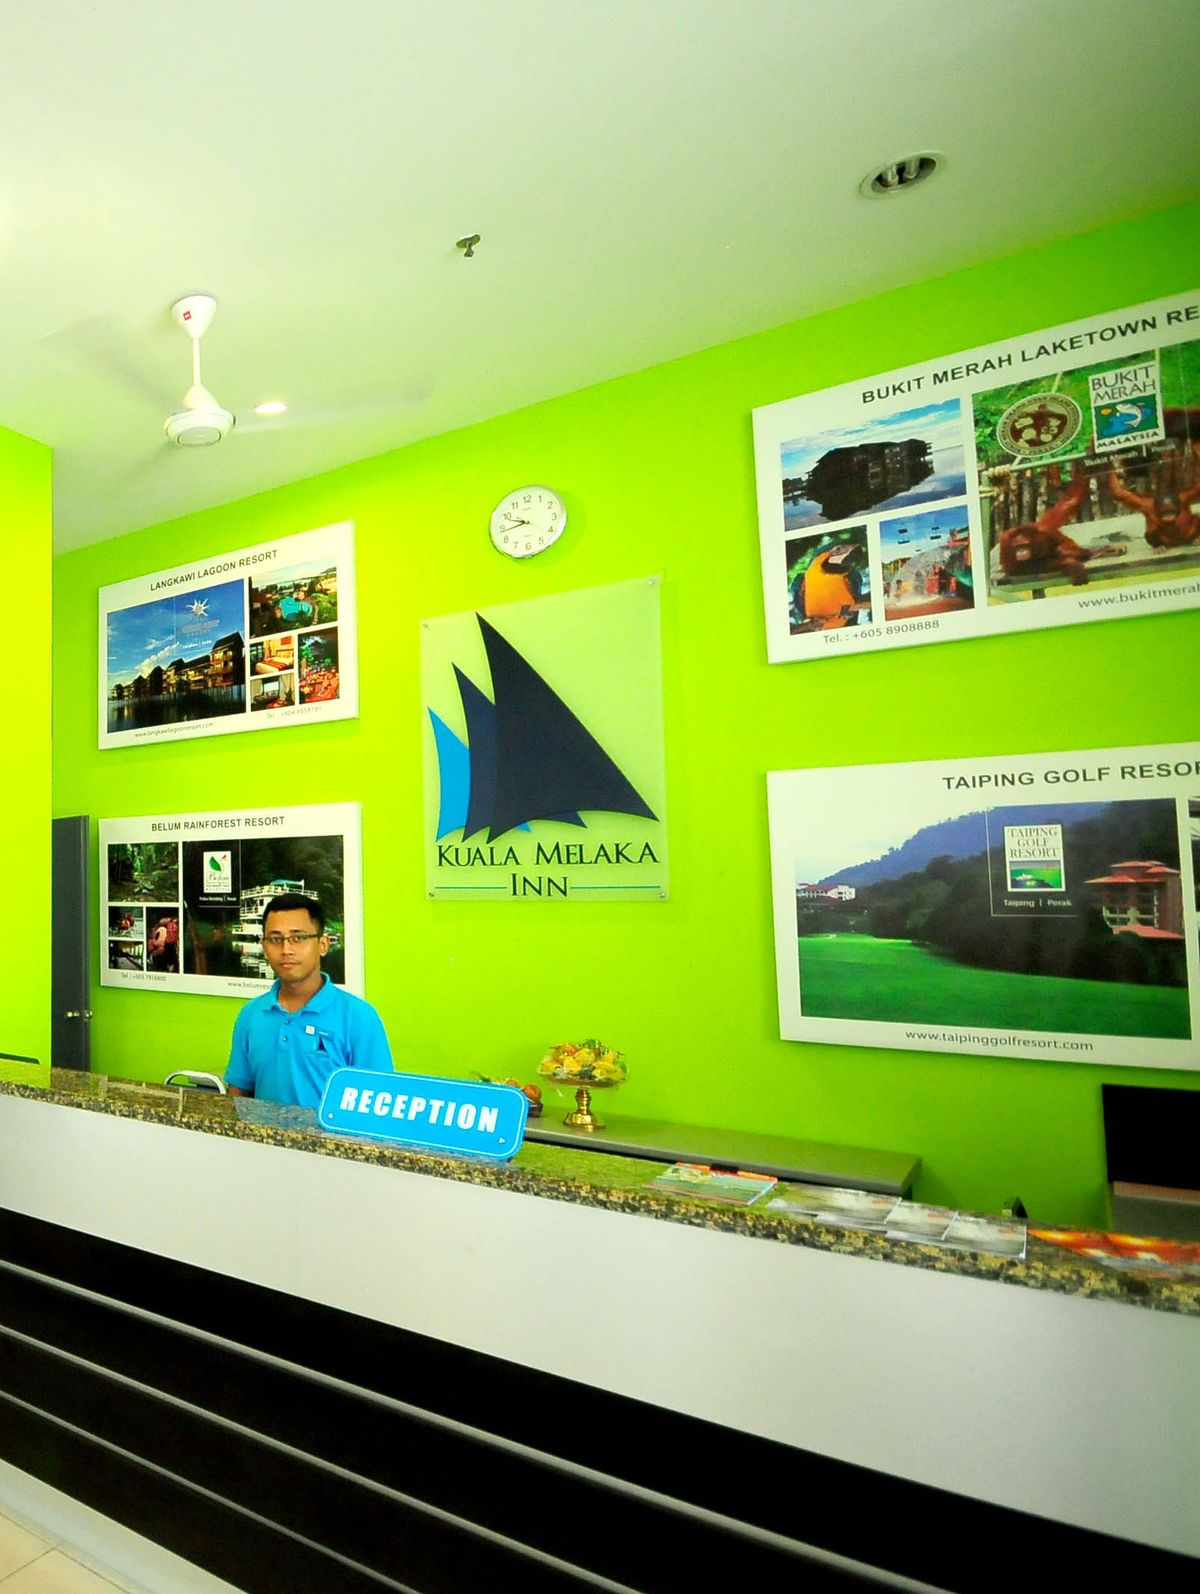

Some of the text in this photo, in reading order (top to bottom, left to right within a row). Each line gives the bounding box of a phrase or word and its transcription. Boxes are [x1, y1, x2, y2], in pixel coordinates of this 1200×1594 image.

[862, 376, 925, 403] BUKIT
[933, 354, 1012, 384] MERAH
[1021, 316, 1157, 361] LAKETOWN
[1092, 365, 1155, 391] BUKIT
[1094, 379, 1155, 403] MERAH
[1097, 431, 1159, 448] MALAYSIA
[523, 495, 532, 503] 12
[547, 501, 553, 509] 2
[504, 512, 512, 520] 10
[552, 512, 557, 520] 3
[525, 542, 531, 550] 6
[539, 536, 544, 544] 5
[150, 550, 277, 591] LANGKAWI LAGOON RESORT
[852, 628, 882, 639] +605
[886, 620, 940, 635] 8908888
[943, 772, 1034, 790] TAIPING
[1044, 767, 1110, 784] GOLF
[152, 816, 285, 831] BELUM RAINFOREST RESORT
[1007, 827, 1058, 838] TAIPING
[1017, 838, 1050, 847] GOLF
[438, 841, 660, 867] KUALA MELAKA
[1009, 848, 1059, 858] RESORT
[511, 873, 568, 897] INN
[1004, 899, 1035, 908] Taiping
[906, 1030, 1094, 1051] www.taipinggolfresort.com
[339, 1086, 499, 1133] RECEPTION
